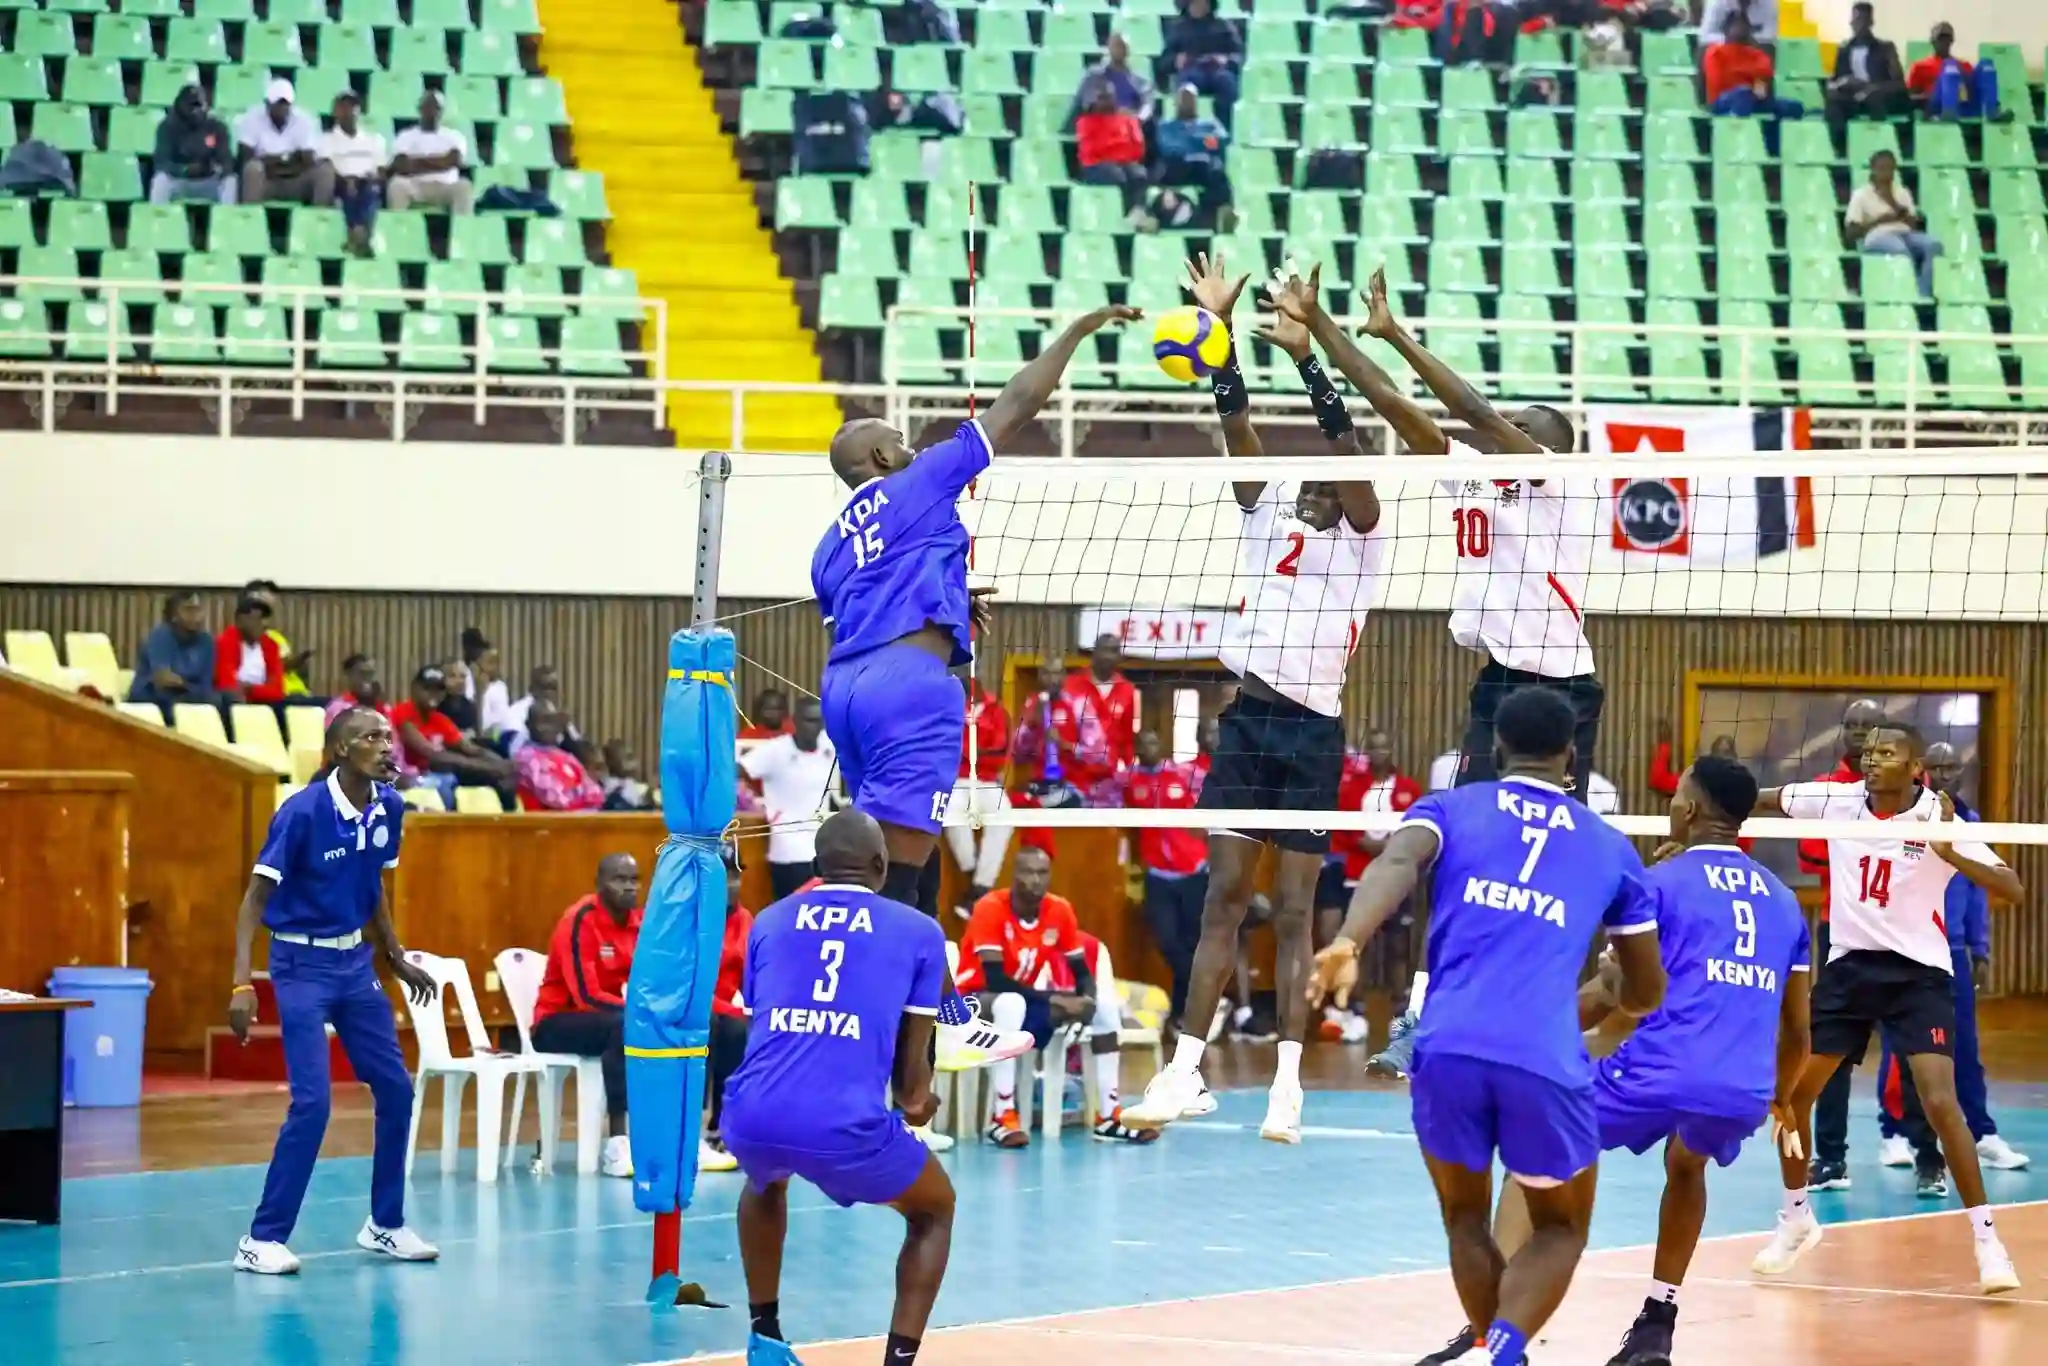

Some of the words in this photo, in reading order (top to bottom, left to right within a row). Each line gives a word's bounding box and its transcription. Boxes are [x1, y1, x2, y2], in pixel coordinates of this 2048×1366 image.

[838, 490, 890, 538] KPA
[1452, 507, 1489, 558] 10
[1623, 498, 1680, 527] KPC
[853, 522, 884, 568] 15
[1276, 531, 1304, 576] 2
[1119, 619, 1208, 642] EXIT
[1497, 789, 1576, 831] KPA
[1518, 825, 1548, 884] 7
[1463, 877, 1565, 928] KENYA
[1704, 864, 1770, 897] KPA
[1859, 855, 1893, 908] 14
[795, 904, 873, 933] KPA
[1732, 900, 1756, 958] 9
[812, 940, 845, 1003] 3
[1707, 958, 1776, 994] KENYA
[769, 1007, 861, 1040] KENYA
